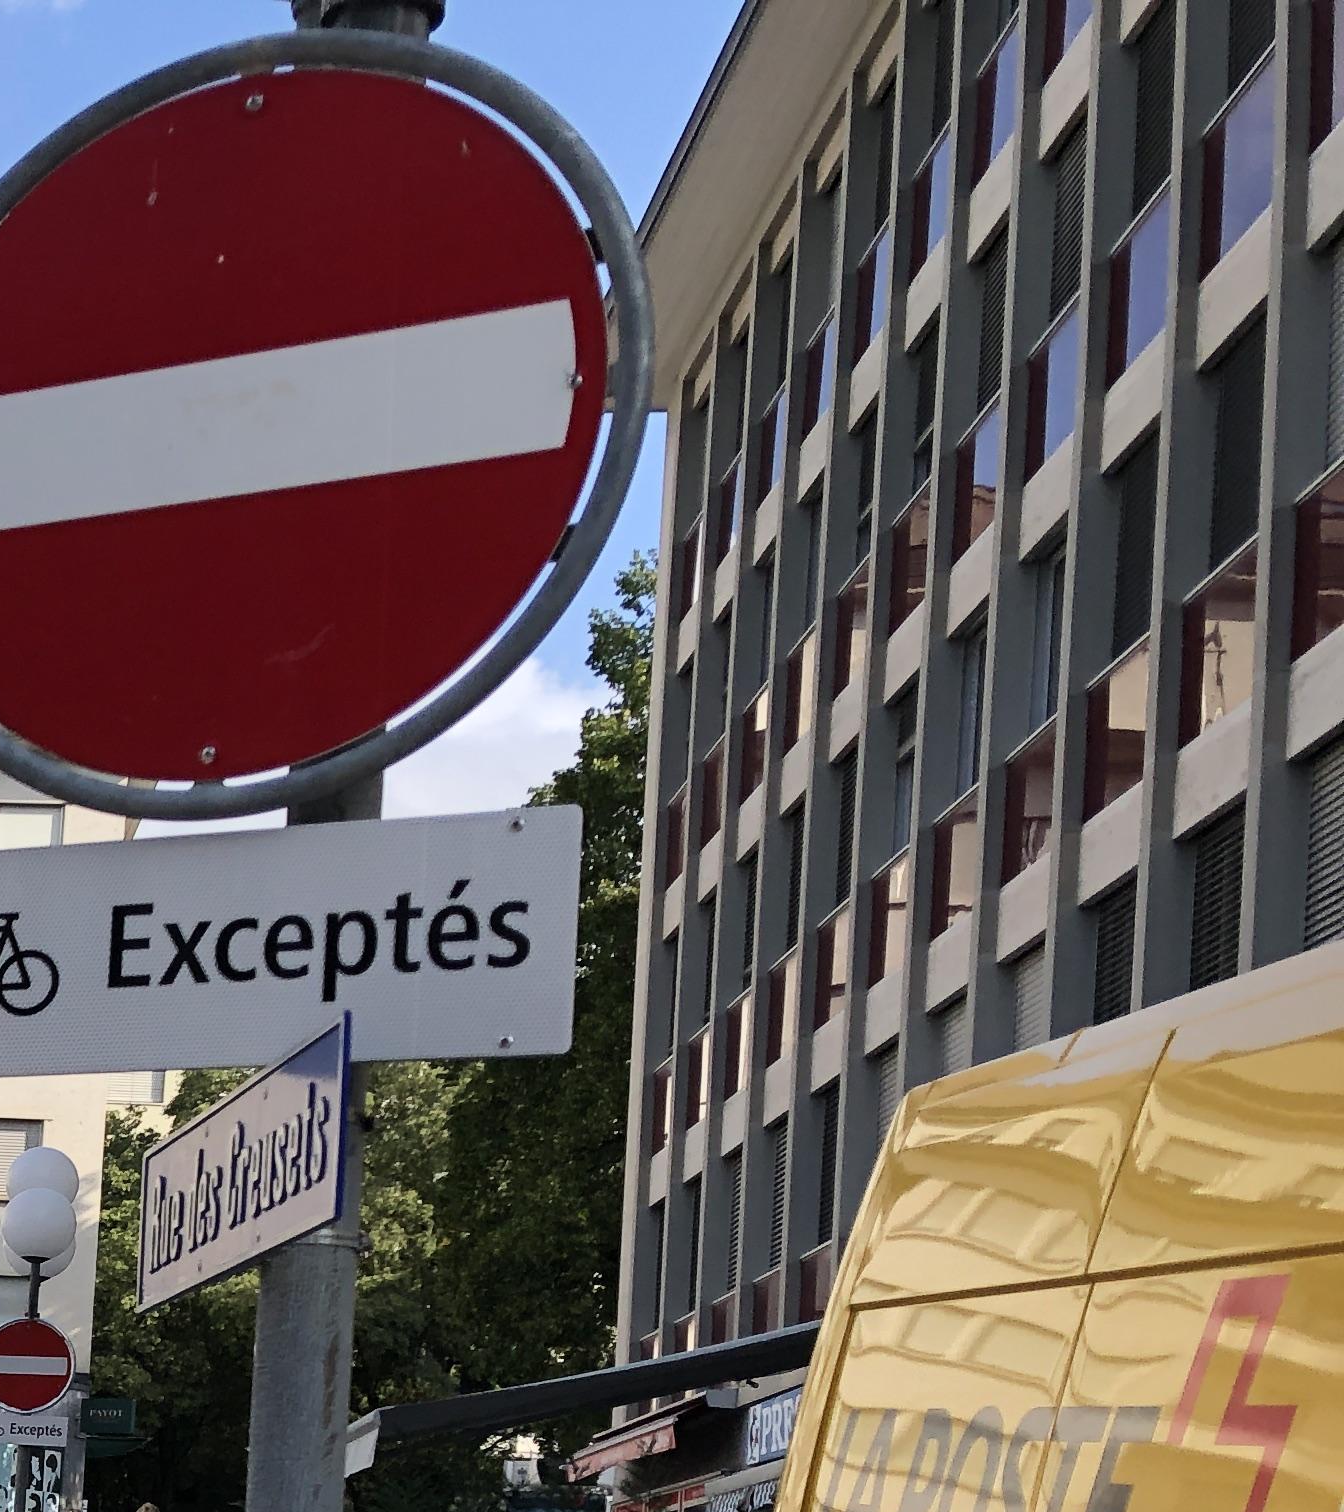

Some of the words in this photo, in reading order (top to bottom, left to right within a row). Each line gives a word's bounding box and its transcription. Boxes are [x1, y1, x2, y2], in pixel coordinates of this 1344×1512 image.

[108, 878, 532, 1003] Exceptés
[150, 1174, 185, 1275] Rue
[187, 1148, 224, 1254] des
[228, 1081, 331, 1231] Creusets
[9, 1422, 63, 1438] Exceptés
